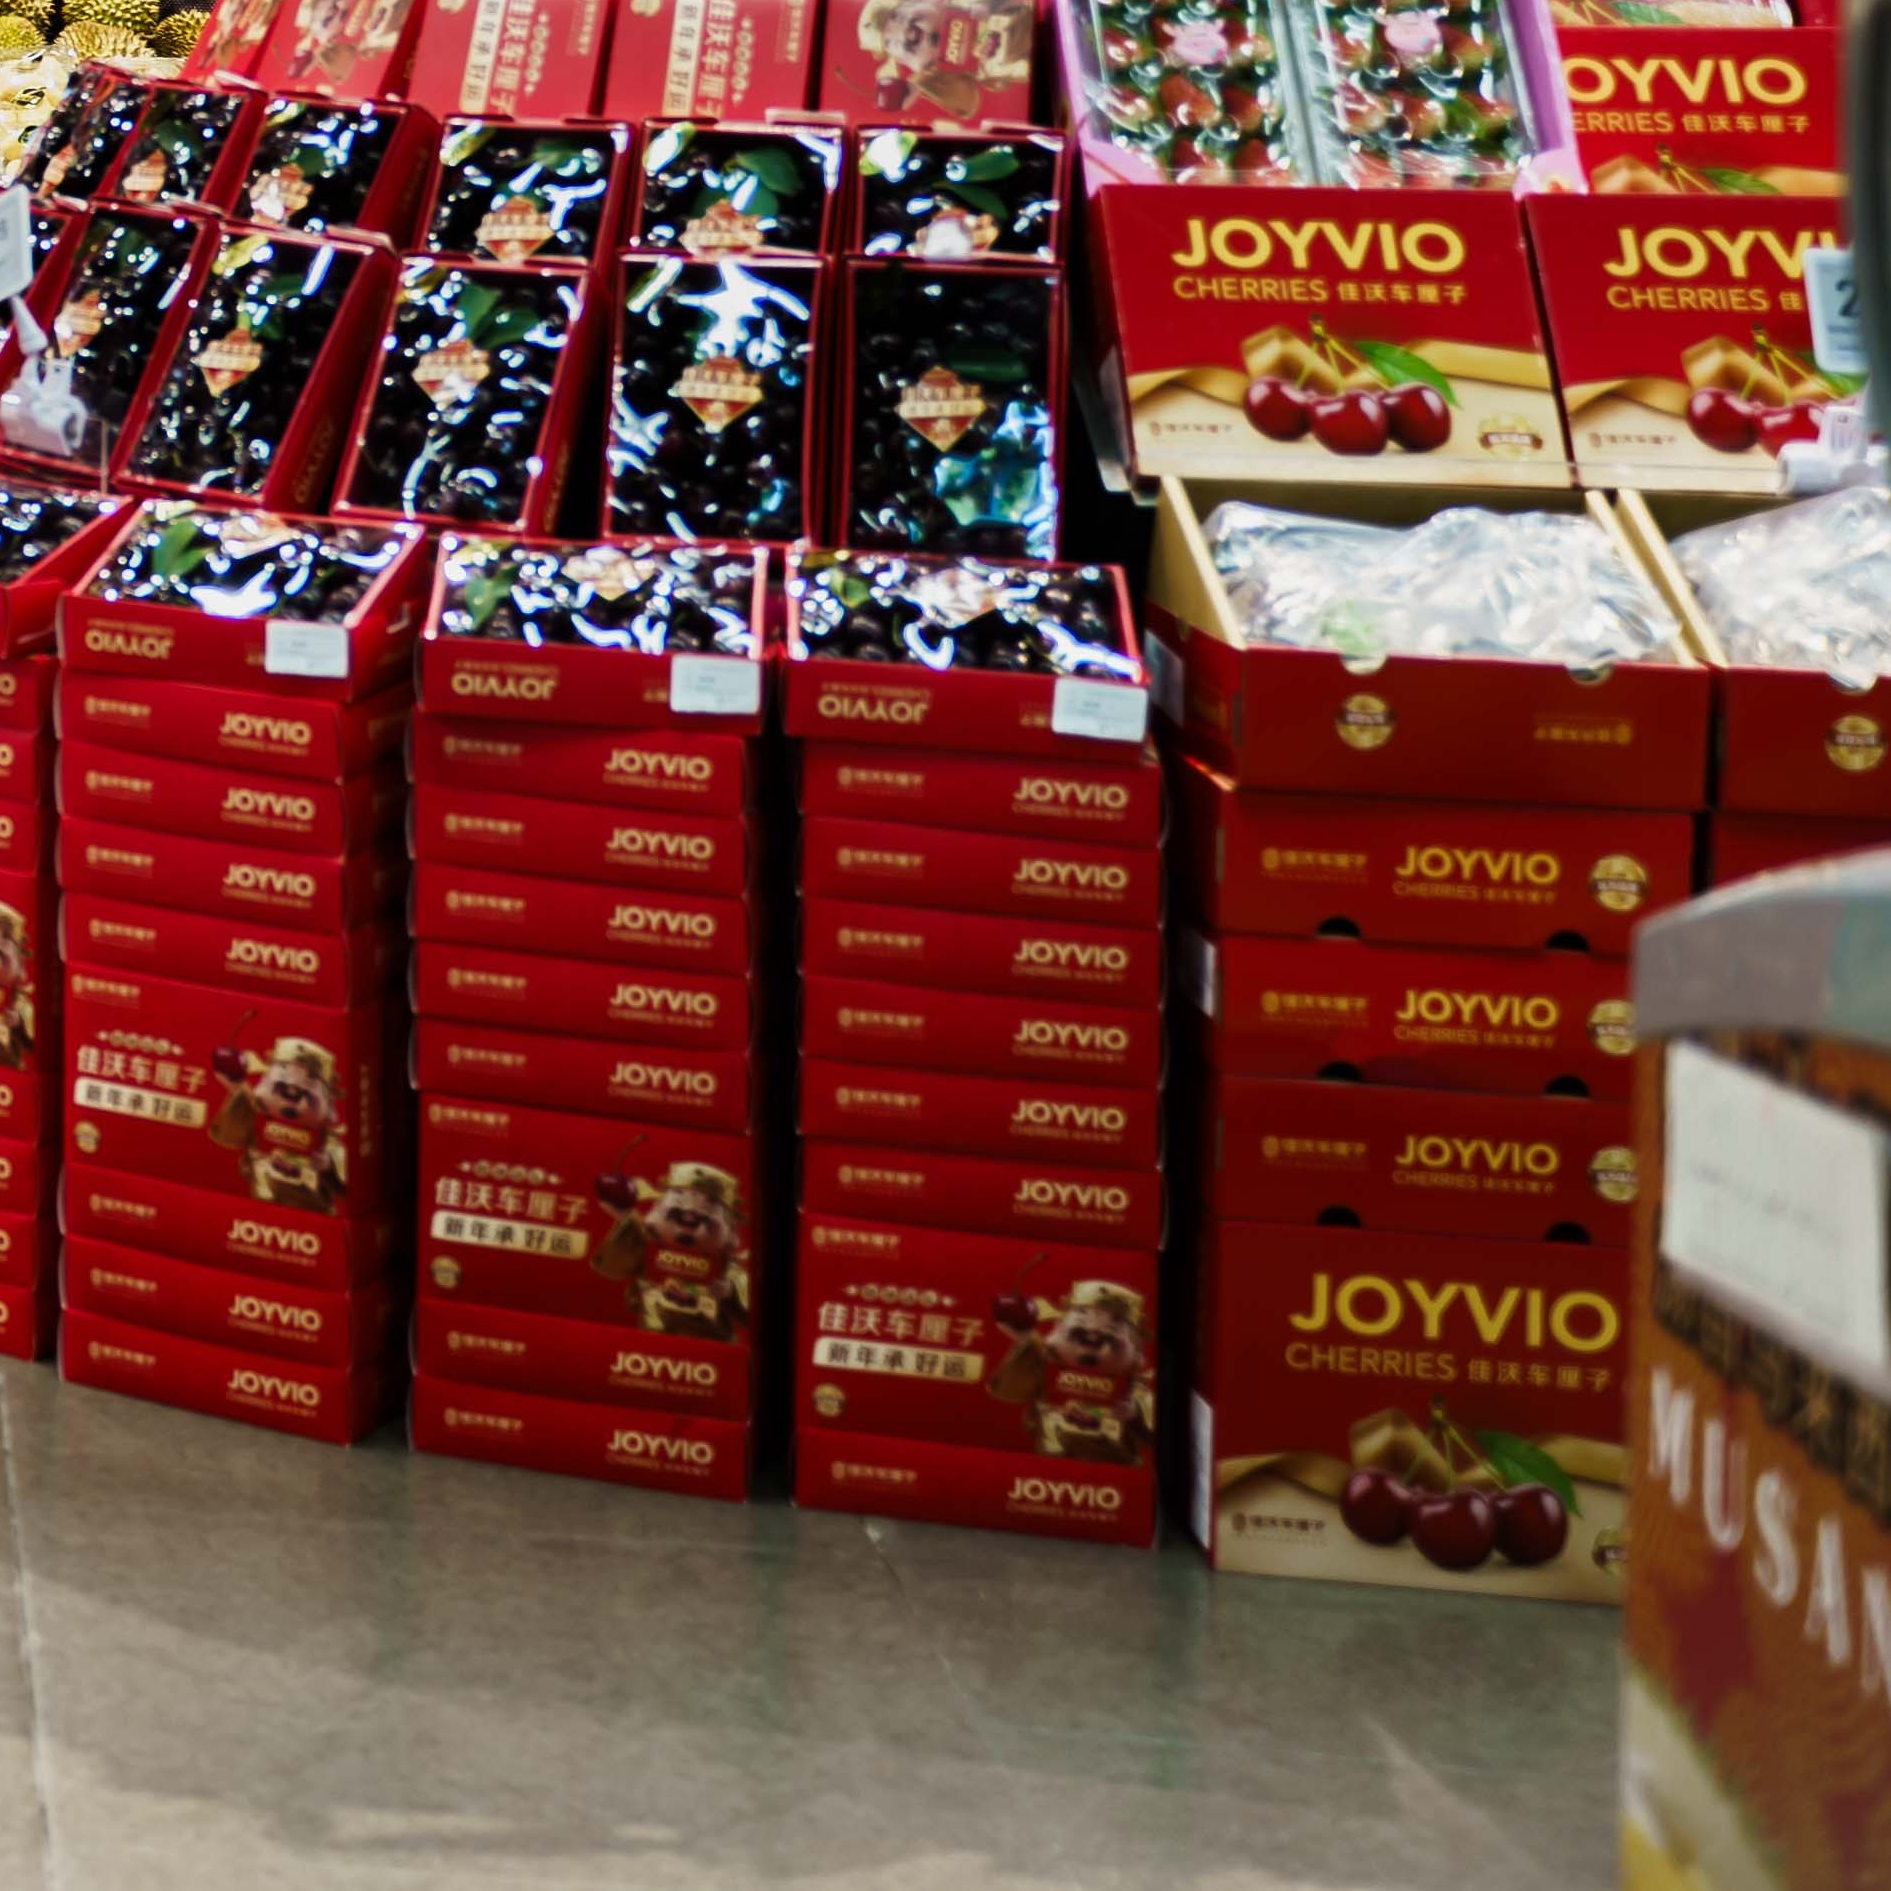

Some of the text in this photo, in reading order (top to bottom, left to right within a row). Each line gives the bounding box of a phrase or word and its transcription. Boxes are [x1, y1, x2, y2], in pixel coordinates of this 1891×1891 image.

[1172, 216, 1466, 275] JOYVIO
[1173, 277, 1466, 306] CHERRIES 佳沃车厘子
[220, 711, 313, 749] JOYVIO
[606, 750, 712, 782] JOYVIO
[1015, 776, 1129, 811] JOYVIO
[1396, 846, 1561, 888] JOYVIO
[1396, 989, 1561, 1032] JOYVIO
[1289, 1273, 1618, 1354] JOYVIO
[1285, 1343, 1611, 1395] CHERRIES 佳沃车厘子
